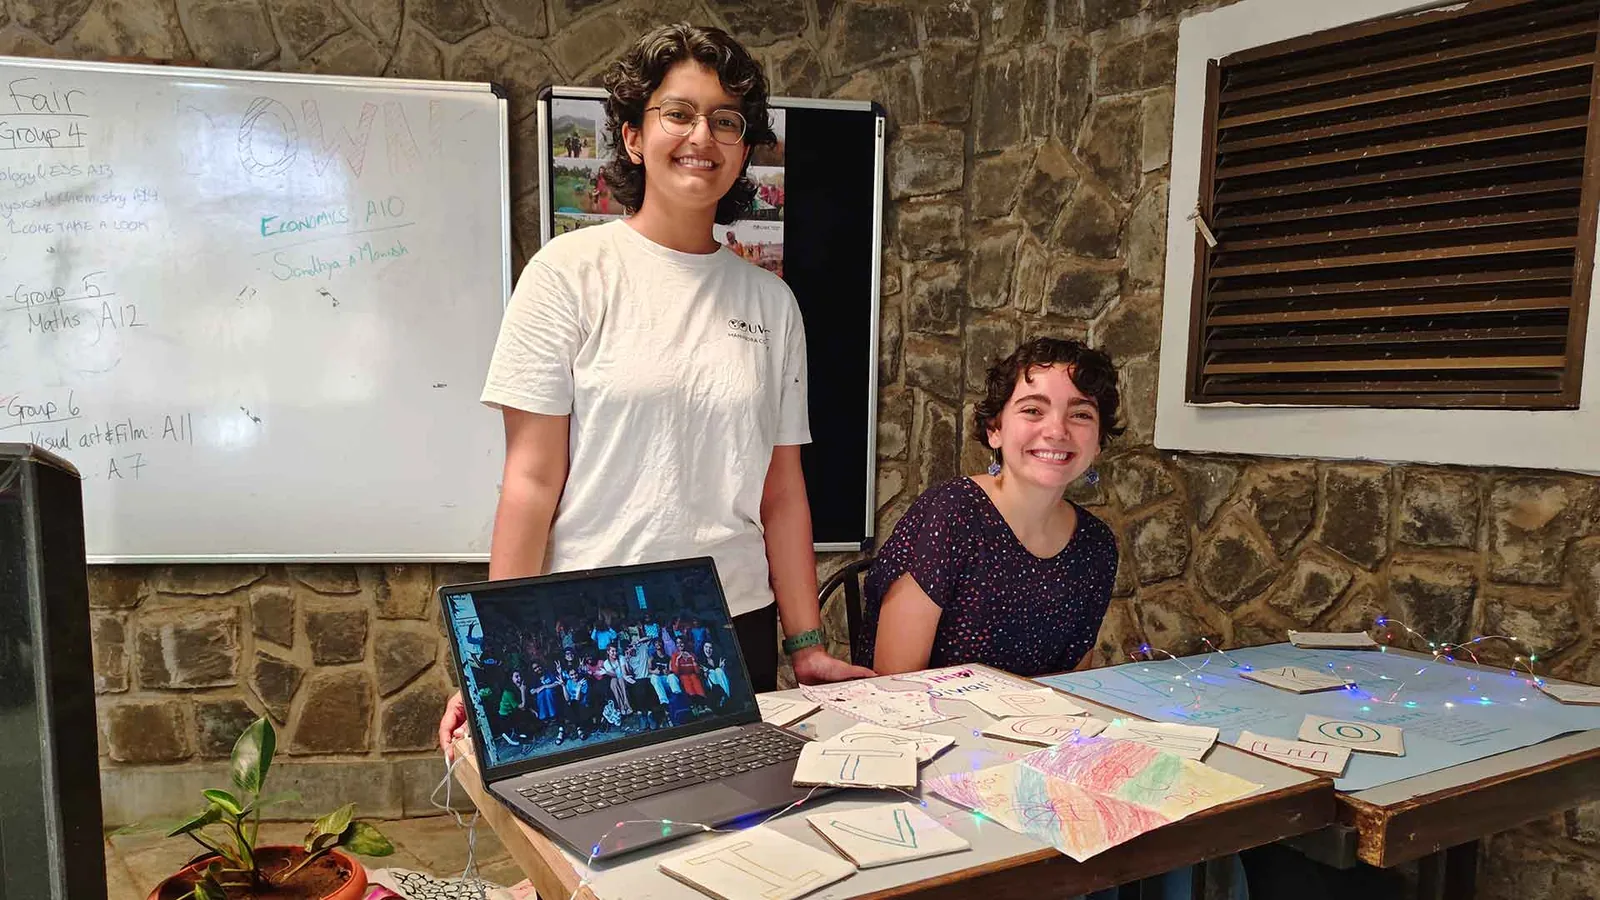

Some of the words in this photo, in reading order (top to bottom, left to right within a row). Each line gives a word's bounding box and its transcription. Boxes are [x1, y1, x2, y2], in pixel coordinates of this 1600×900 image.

[8, 77, 86, 113] Fair
[0, 121, 60, 149] Group
[68, 122, 87, 148] 4
[81, 270, 107, 298] 5
[28, 311, 81, 334] Maths
[100, 300, 146, 330] A12
[68, 389, 80, 417] 6
